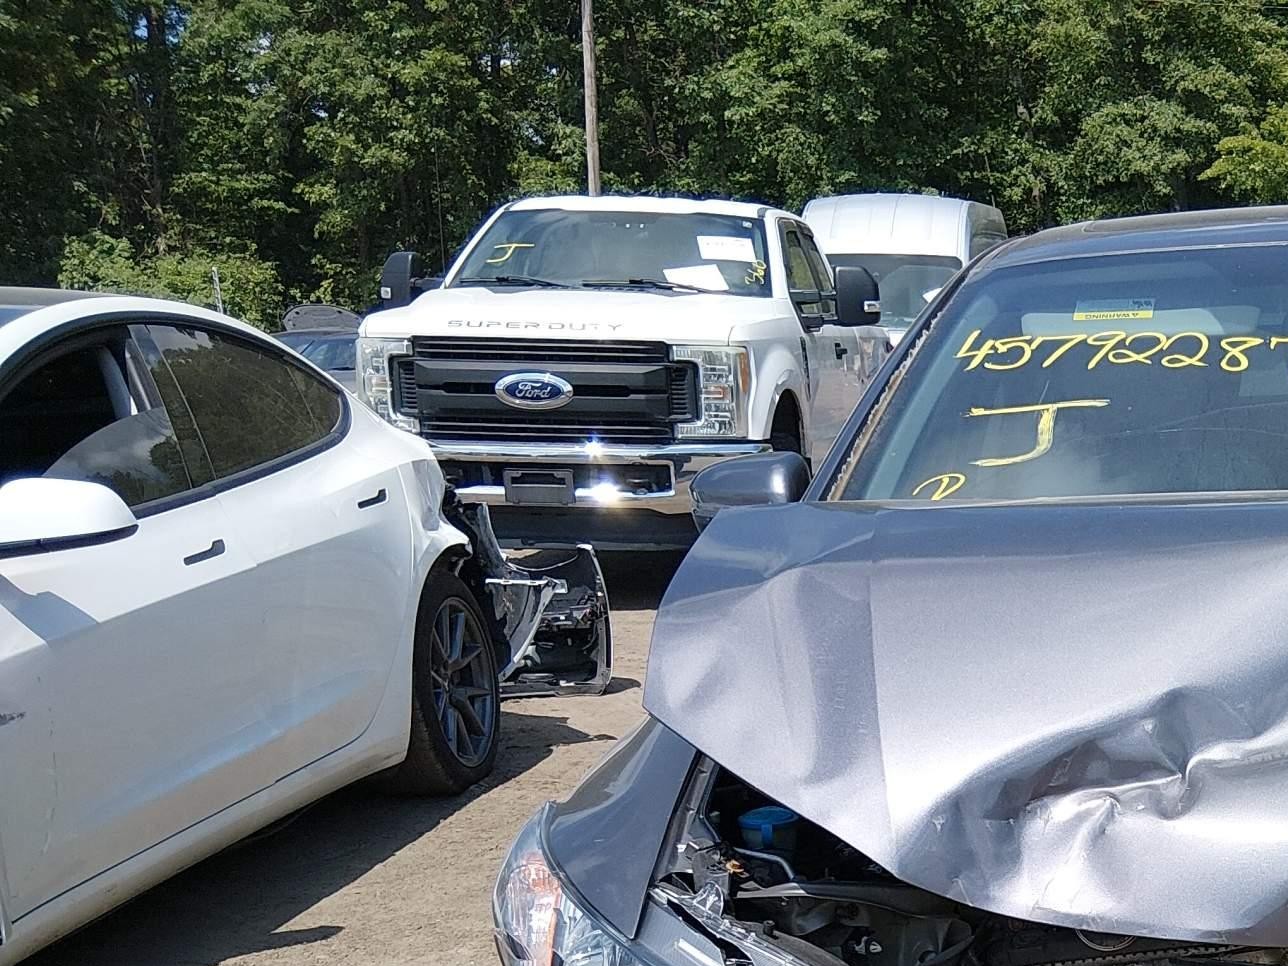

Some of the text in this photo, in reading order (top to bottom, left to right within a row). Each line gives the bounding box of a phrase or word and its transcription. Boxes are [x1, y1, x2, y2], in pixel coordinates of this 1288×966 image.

[447, 319, 623, 332] SUPER DUTY
[514, 381, 553, 399] Ford
